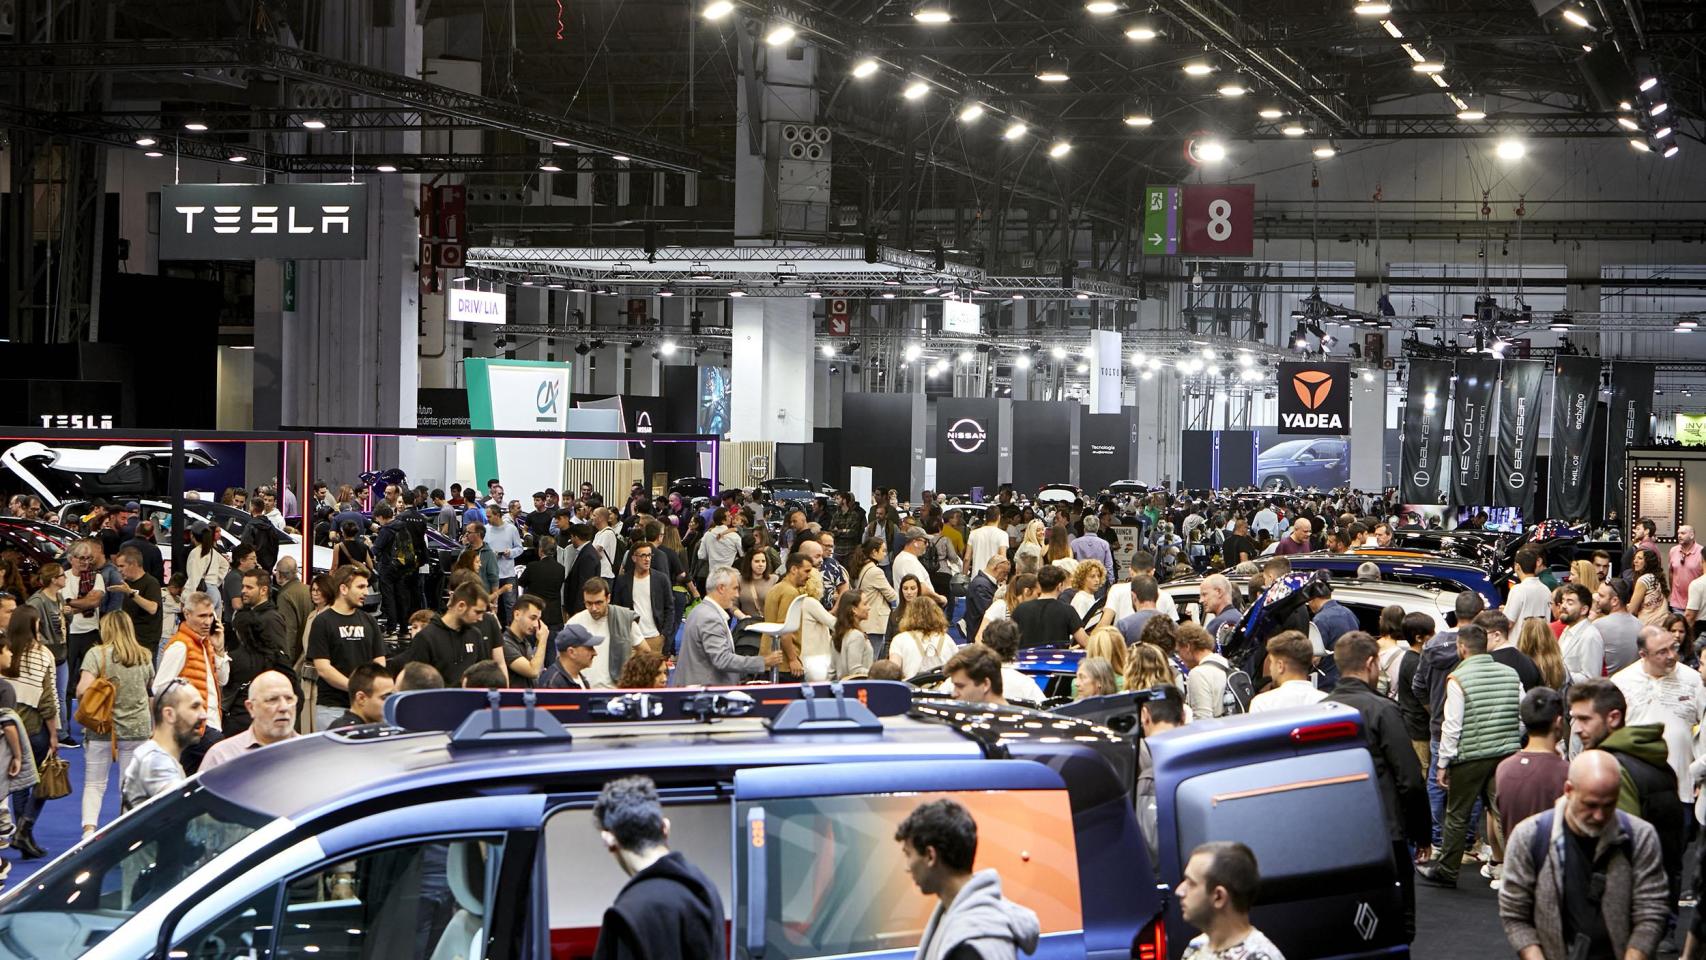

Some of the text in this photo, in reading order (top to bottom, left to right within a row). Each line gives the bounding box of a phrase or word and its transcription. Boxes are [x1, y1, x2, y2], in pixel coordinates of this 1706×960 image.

[175, 206, 350, 234] TESLA
[1207, 199, 1232, 242] 8
[40, 414, 113, 430] TESLA
[417, 416, 438, 426] ccidentes
[452, 416, 471, 426] emisione
[1281, 413, 1343, 429] YADEA
[947, 432, 987, 440] NISSAN
[1460, 397, 1475, 487] REVOLT
